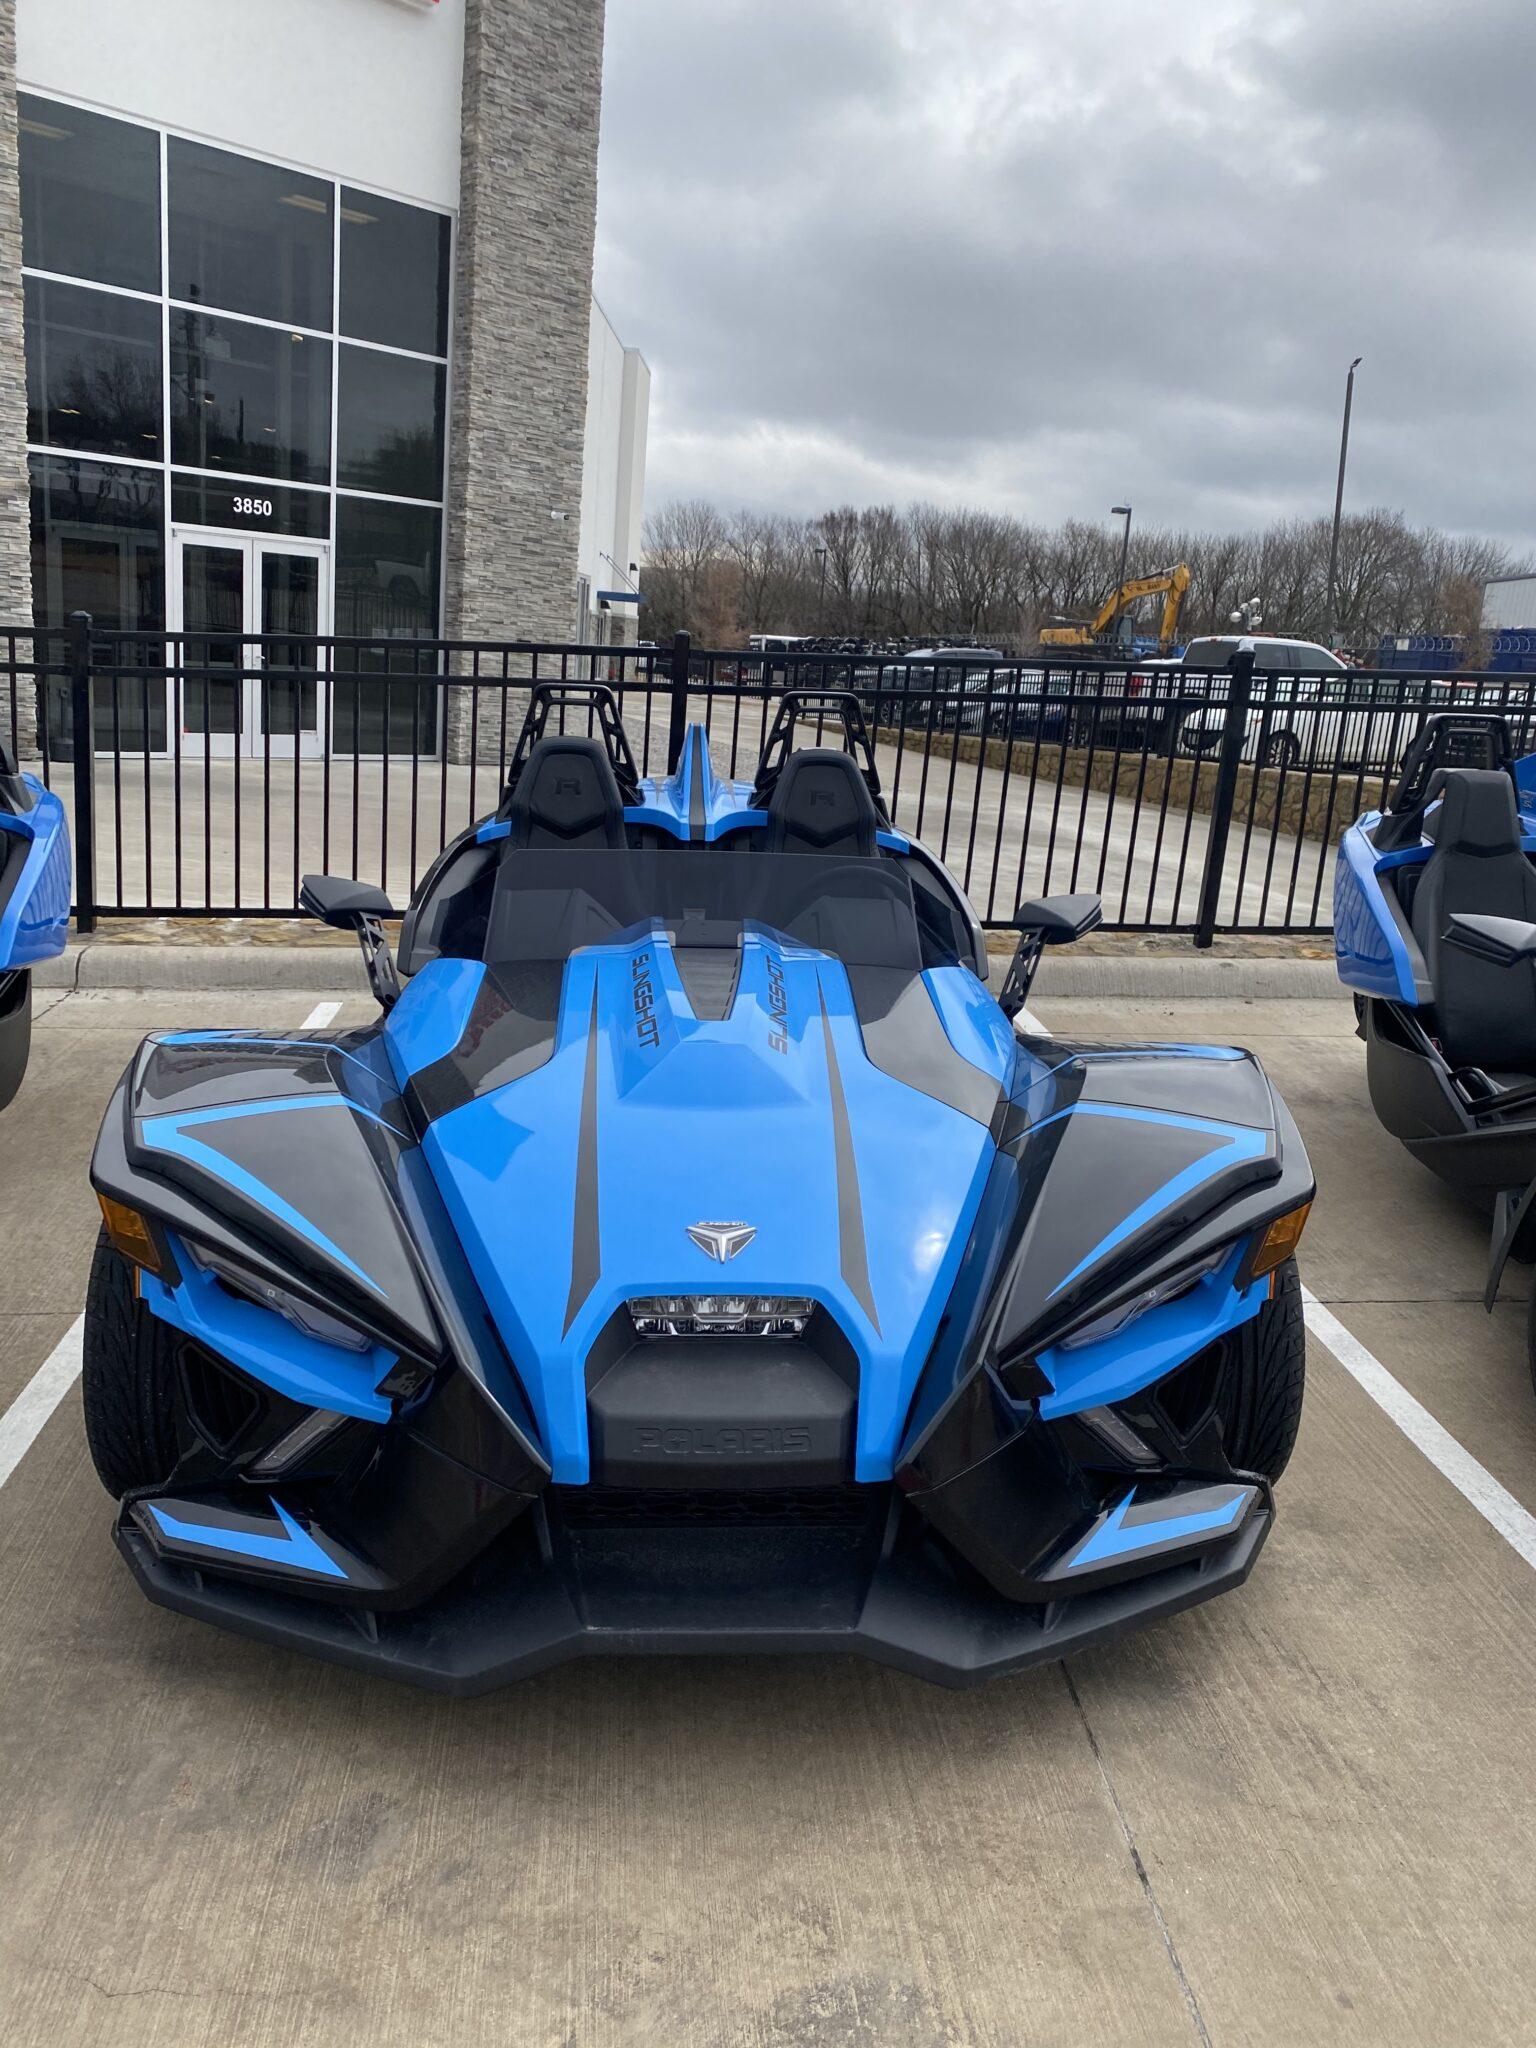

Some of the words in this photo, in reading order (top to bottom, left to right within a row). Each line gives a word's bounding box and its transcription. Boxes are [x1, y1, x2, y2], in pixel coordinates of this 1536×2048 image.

[232, 496, 273, 517] 3850
[632, 953, 660, 1048] SLINGSHOT
[766, 954, 788, 1056] SLINGSHOT
[633, 1426, 812, 1454] POLARIS
